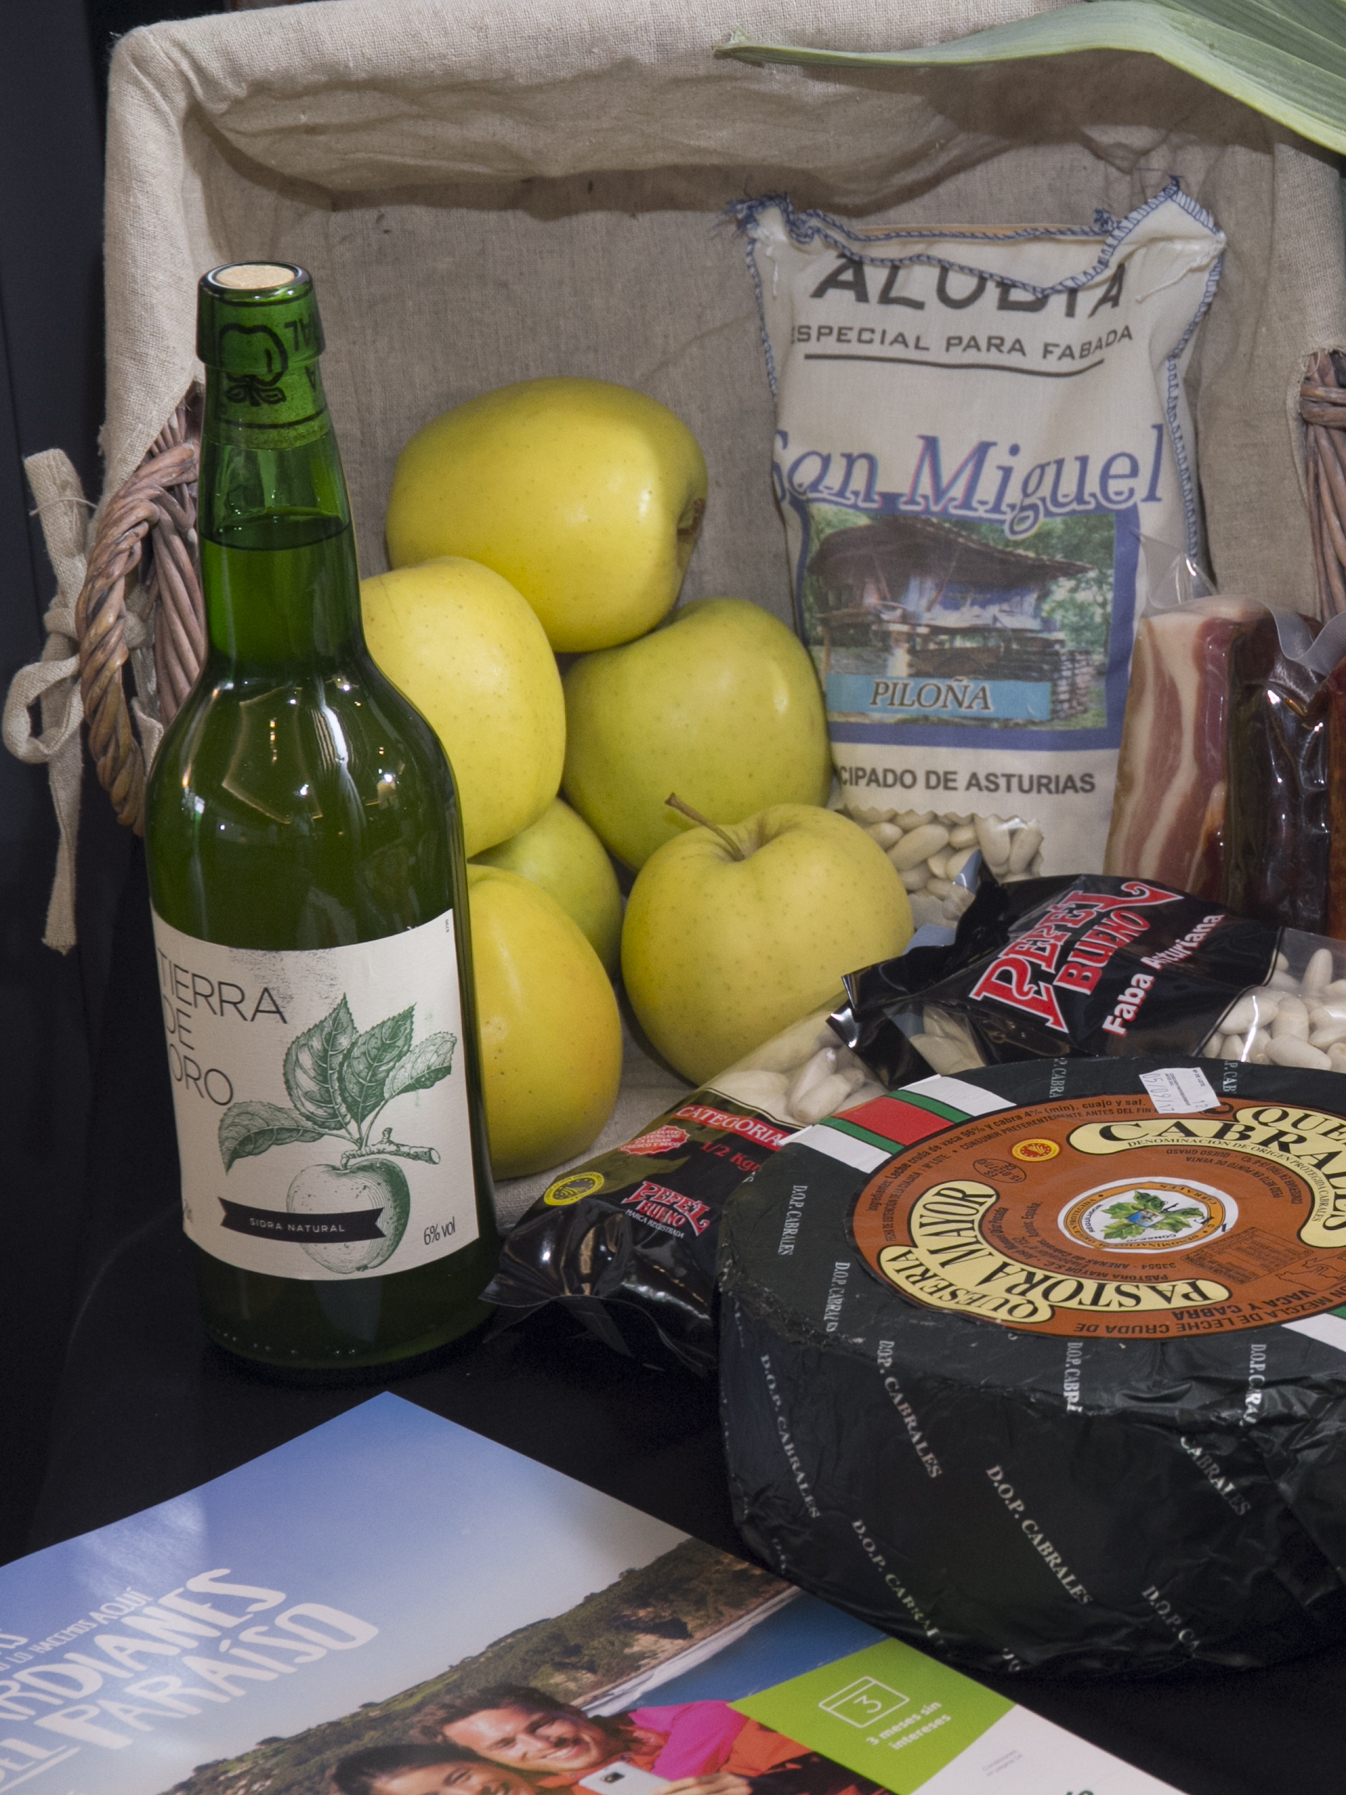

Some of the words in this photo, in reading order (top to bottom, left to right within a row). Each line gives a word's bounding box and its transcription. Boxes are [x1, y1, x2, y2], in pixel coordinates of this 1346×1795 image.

[945, 335, 1027, 357] PARA
[1042, 324, 1134, 360] FABADA
[904, 423, 1167, 540] Miguel
[869, 677, 993, 711] PILOÑA
[924, 770, 959, 791] DE
[964, 771, 1097, 795] ASTURIAS
[1052, 909, 1151, 995] BUENO
[157, 947, 288, 1024] TIERRA
[1102, 973, 1155, 1037] Faba
[1140, 914, 1226, 972] Asturiana
[168, 1043, 234, 1106] ORO
[675, 1106, 786, 1147] CATEGORIA
[885, 1163, 912, 1180] Leche
[908, 1150, 931, 1165] cruda
[940, 1135, 963, 1147] vaca
[961, 1126, 985, 1138] 96%
[994, 1114, 1022, 1131] cabra
[1082, 1100, 1113, 1110] cuajo
[960, 1130, 1001, 1150] CONSUMIR
[1001, 1112, 1084, 1135] PREFERENTEMENTE
[1086, 1108, 1114, 1117] ANTES
[701, 1142, 730, 1157] 1/2
[1185, 1156, 1214, 1164] VENTA
[1199, 1150, 1230, 1158] QUESO
[1127, 1136, 1231, 1148] DENOMINACIÓN
[1250, 1146, 1292, 1164] ORIGEN
[1292, 1158, 1327, 1190] PROTEGIDA
[1312, 1189, 1330, 1222] CABRALES
[1227, 1162, 1253, 1175] PUNTO
[635, 1200, 687, 1227] BUENO
[789, 1184, 809, 1214] D.O.P.
[249, 1216, 283, 1231] SIDRA
[287, 1222, 346, 1233] NATURAL
[423, 1223, 441, 1246] 6%
[441, 1216, 456, 1238] vol
[625, 1209, 648, 1224] MARCA
[648, 1220, 685, 1239] REGISTRADA
[777, 1213, 802, 1256] CABRALES
[918, 1186, 997, 1269] MAYOR
[1066, 1267, 1109, 1279] MAYOR
[1089, 1260, 1130, 1270] ARENAS
[1111, 1273, 1169, 1281] PASTORA
[1141, 1262, 1176, 1270] 33554
[974, 1260, 1216, 1310] PASTORA
[1261, 1290, 1317, 1306] VACA
[1171, 1305, 1243, 1321] CABRA
[1237, 1313, 1263, 1324] DE
[1248, 1303, 1263, 1311] Y
[1265, 1296, 1333, 1318] MEZCLA
[1075, 1323, 1101, 1333] DE
[1105, 1324, 1170, 1335] CRUDA
[1176, 1316, 1235, 1332] LECHE
[877, 1340, 895, 1374] D.O.P.
[1067, 1341, 1083, 1366] D.O.P.
[1249, 1343, 1267, 1374] D.O.P.
[884, 1376, 943, 1479] CABRALES
[777, 1415, 821, 1519] CABRALES
[1180, 1436, 1251, 1517] CABRALES
[853, 1520, 887, 1572] D.O.P.
[986, 1465, 1024, 1519] D.O.P.
[1021, 1518, 1093, 1605] CABRALES
[28, 1619, 98, 1654] HACEMOS
[88, 1586, 154, 1625] AQUÍ
[33, 1602, 380, 1750] PARAÍSO
[853, 1694, 882, 1714] 3
[865, 1736, 880, 1746] 3
[878, 1711, 922, 1741] meses
[920, 1701, 942, 1717] sin
[888, 1713, 952, 1750] intereses
